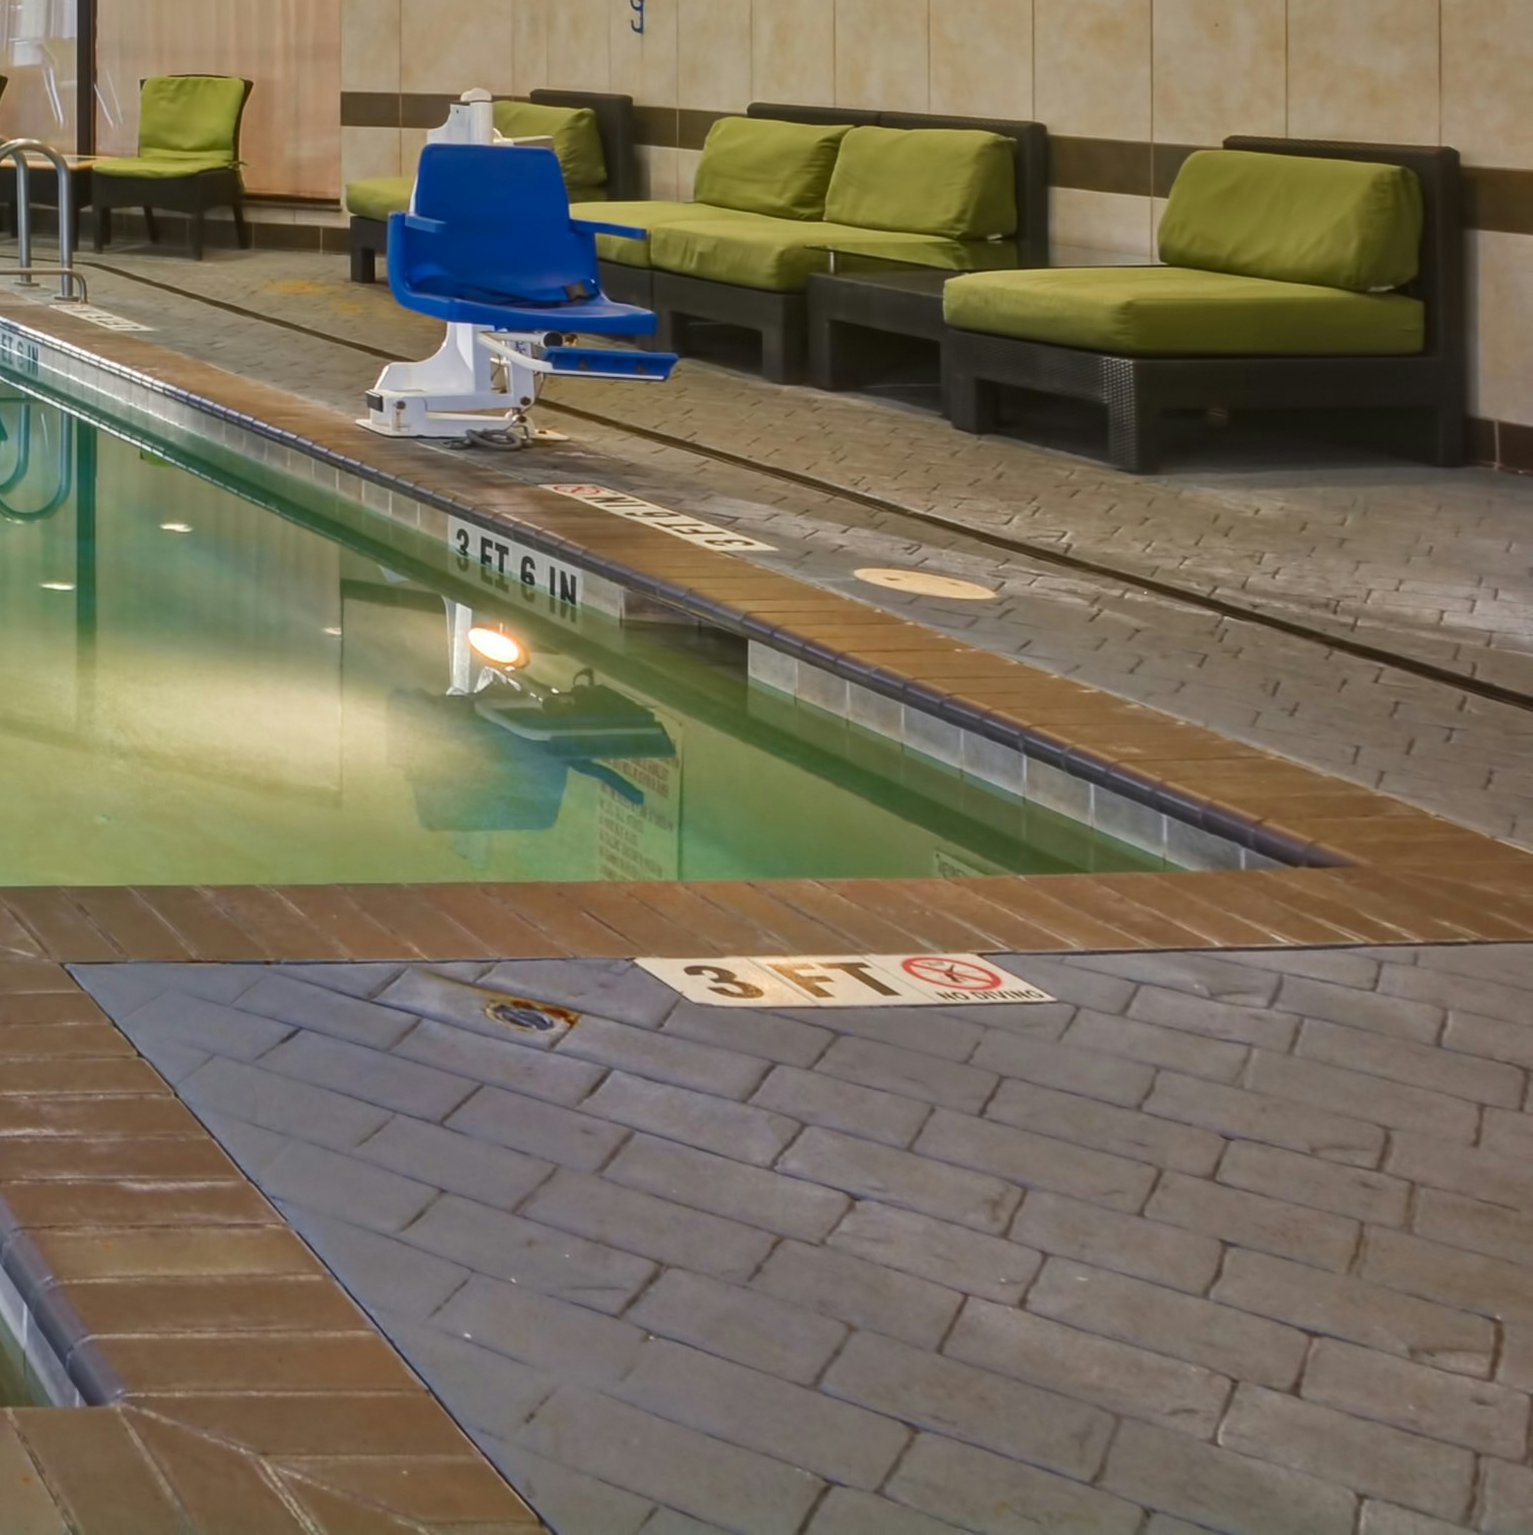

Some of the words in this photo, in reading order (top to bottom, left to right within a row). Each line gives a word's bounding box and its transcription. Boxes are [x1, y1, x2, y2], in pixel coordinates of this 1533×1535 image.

[456, 528, 469, 556] 3
[480, 536, 509, 574] FT
[520, 555, 536, 586] 6
[549, 565, 576, 605] IN
[683, 965, 764, 999] 3
[766, 962, 901, 998] FT
[937, 991, 971, 1001] NO
[974, 990, 1045, 1000] DIVING
